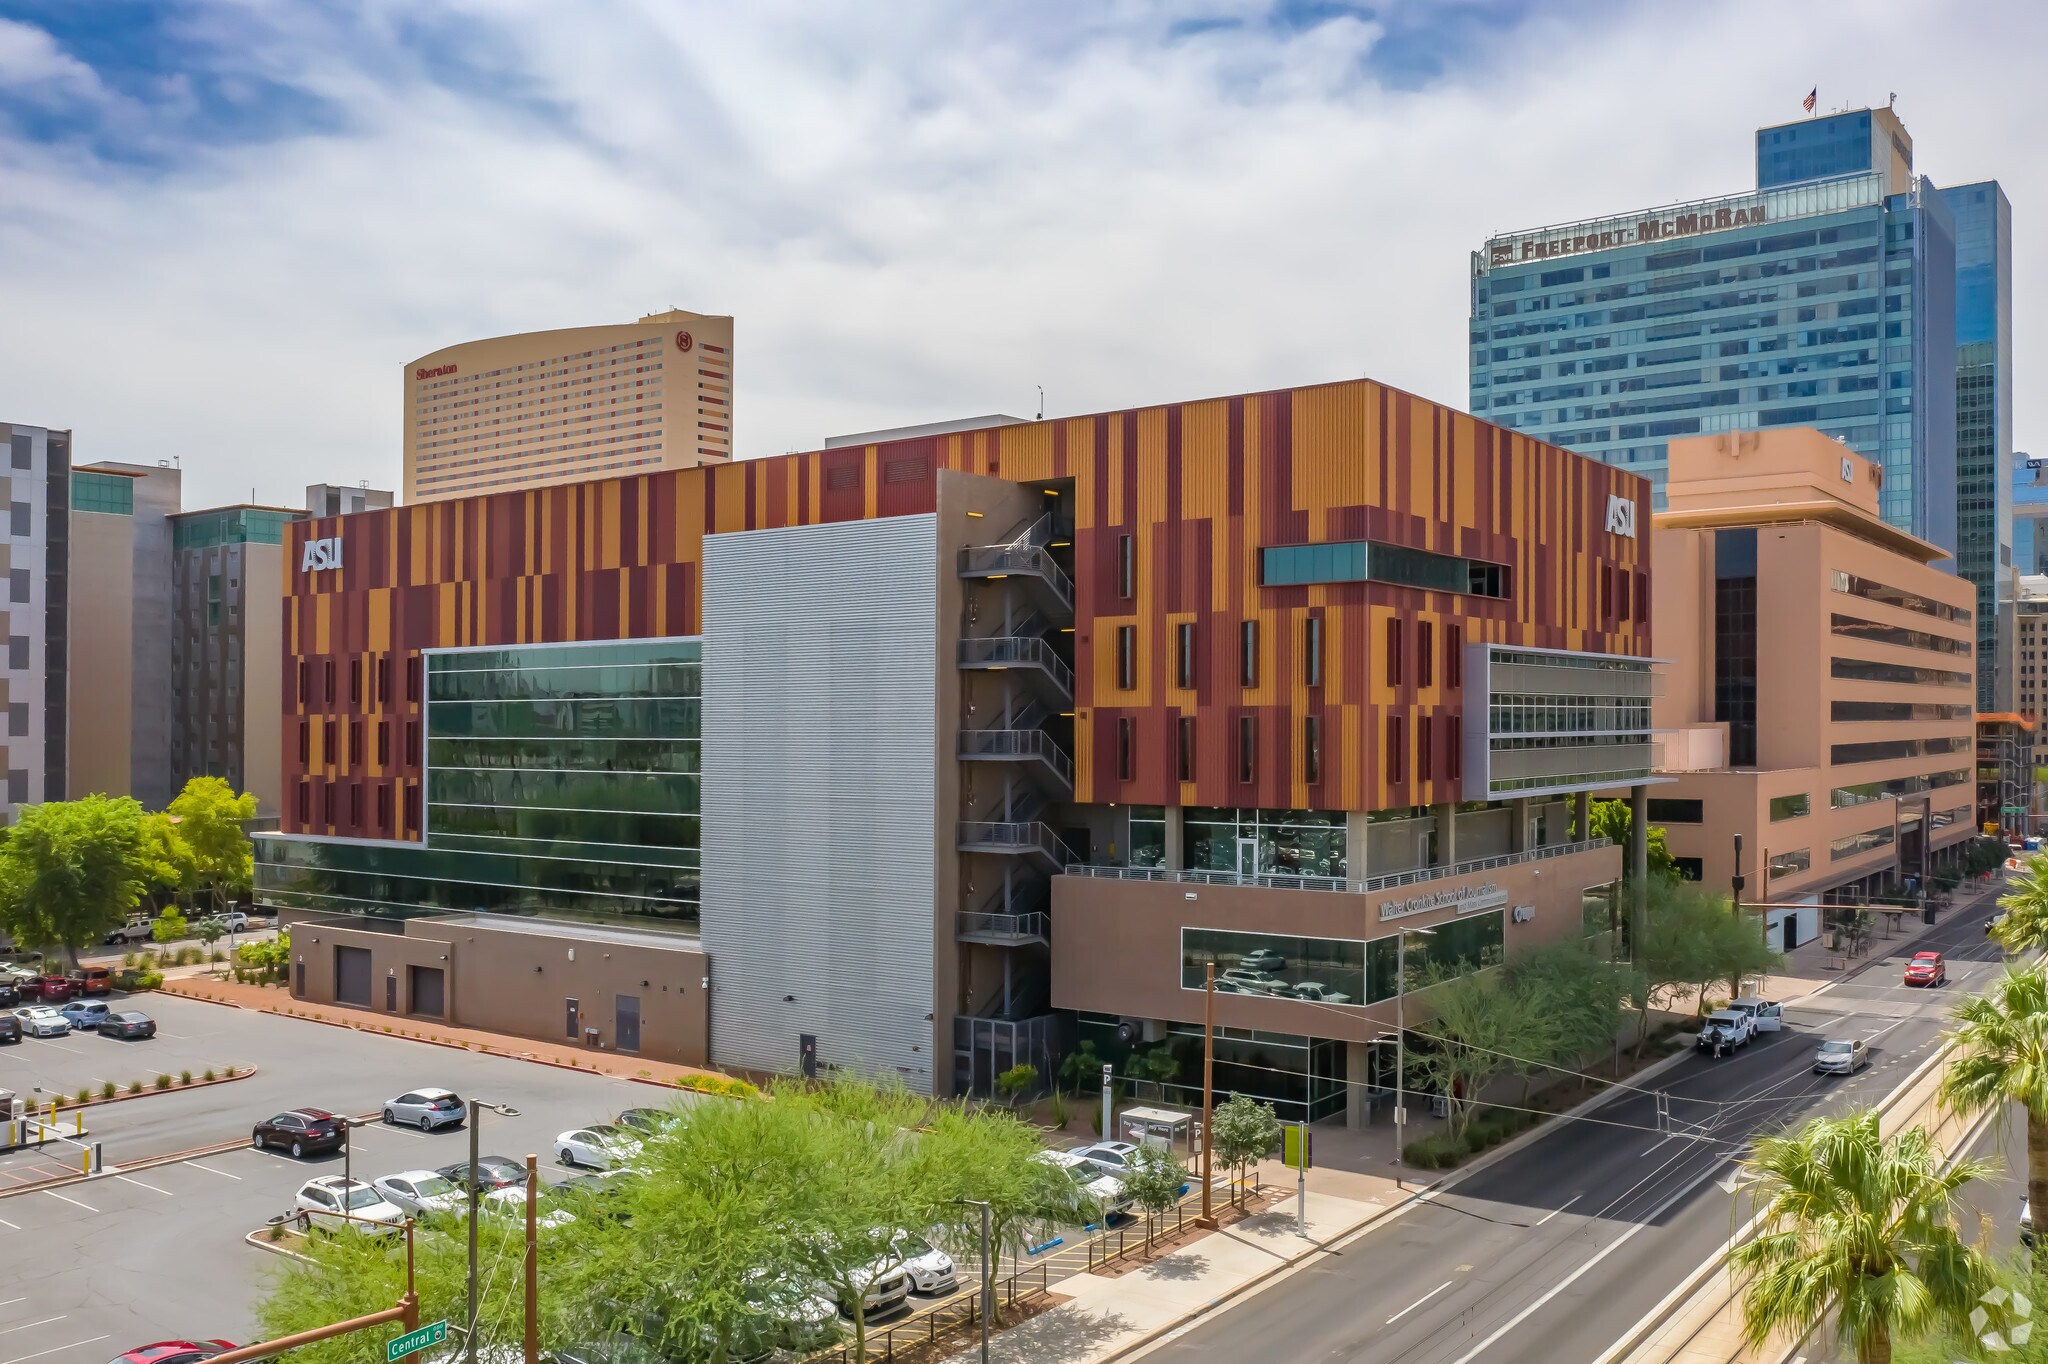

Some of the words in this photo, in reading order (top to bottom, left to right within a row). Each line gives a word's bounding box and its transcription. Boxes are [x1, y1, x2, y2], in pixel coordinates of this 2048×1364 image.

[416, 364, 458, 380] Sheraton
[1604, 493, 1636, 539] ASU
[302, 537, 343, 573] ASU
[1380, 900, 1405, 917] Walter
[1406, 893, 1436, 912] Cronkite
[1436, 890, 1457, 906] School
[1458, 886, 1467, 902] of
[1467, 881, 1498, 898] Journalism
[1104, 1074, 1111, 1085] P
[1195, 1128, 1201, 1138] P
[392, 1331, 430, 1355] Central
